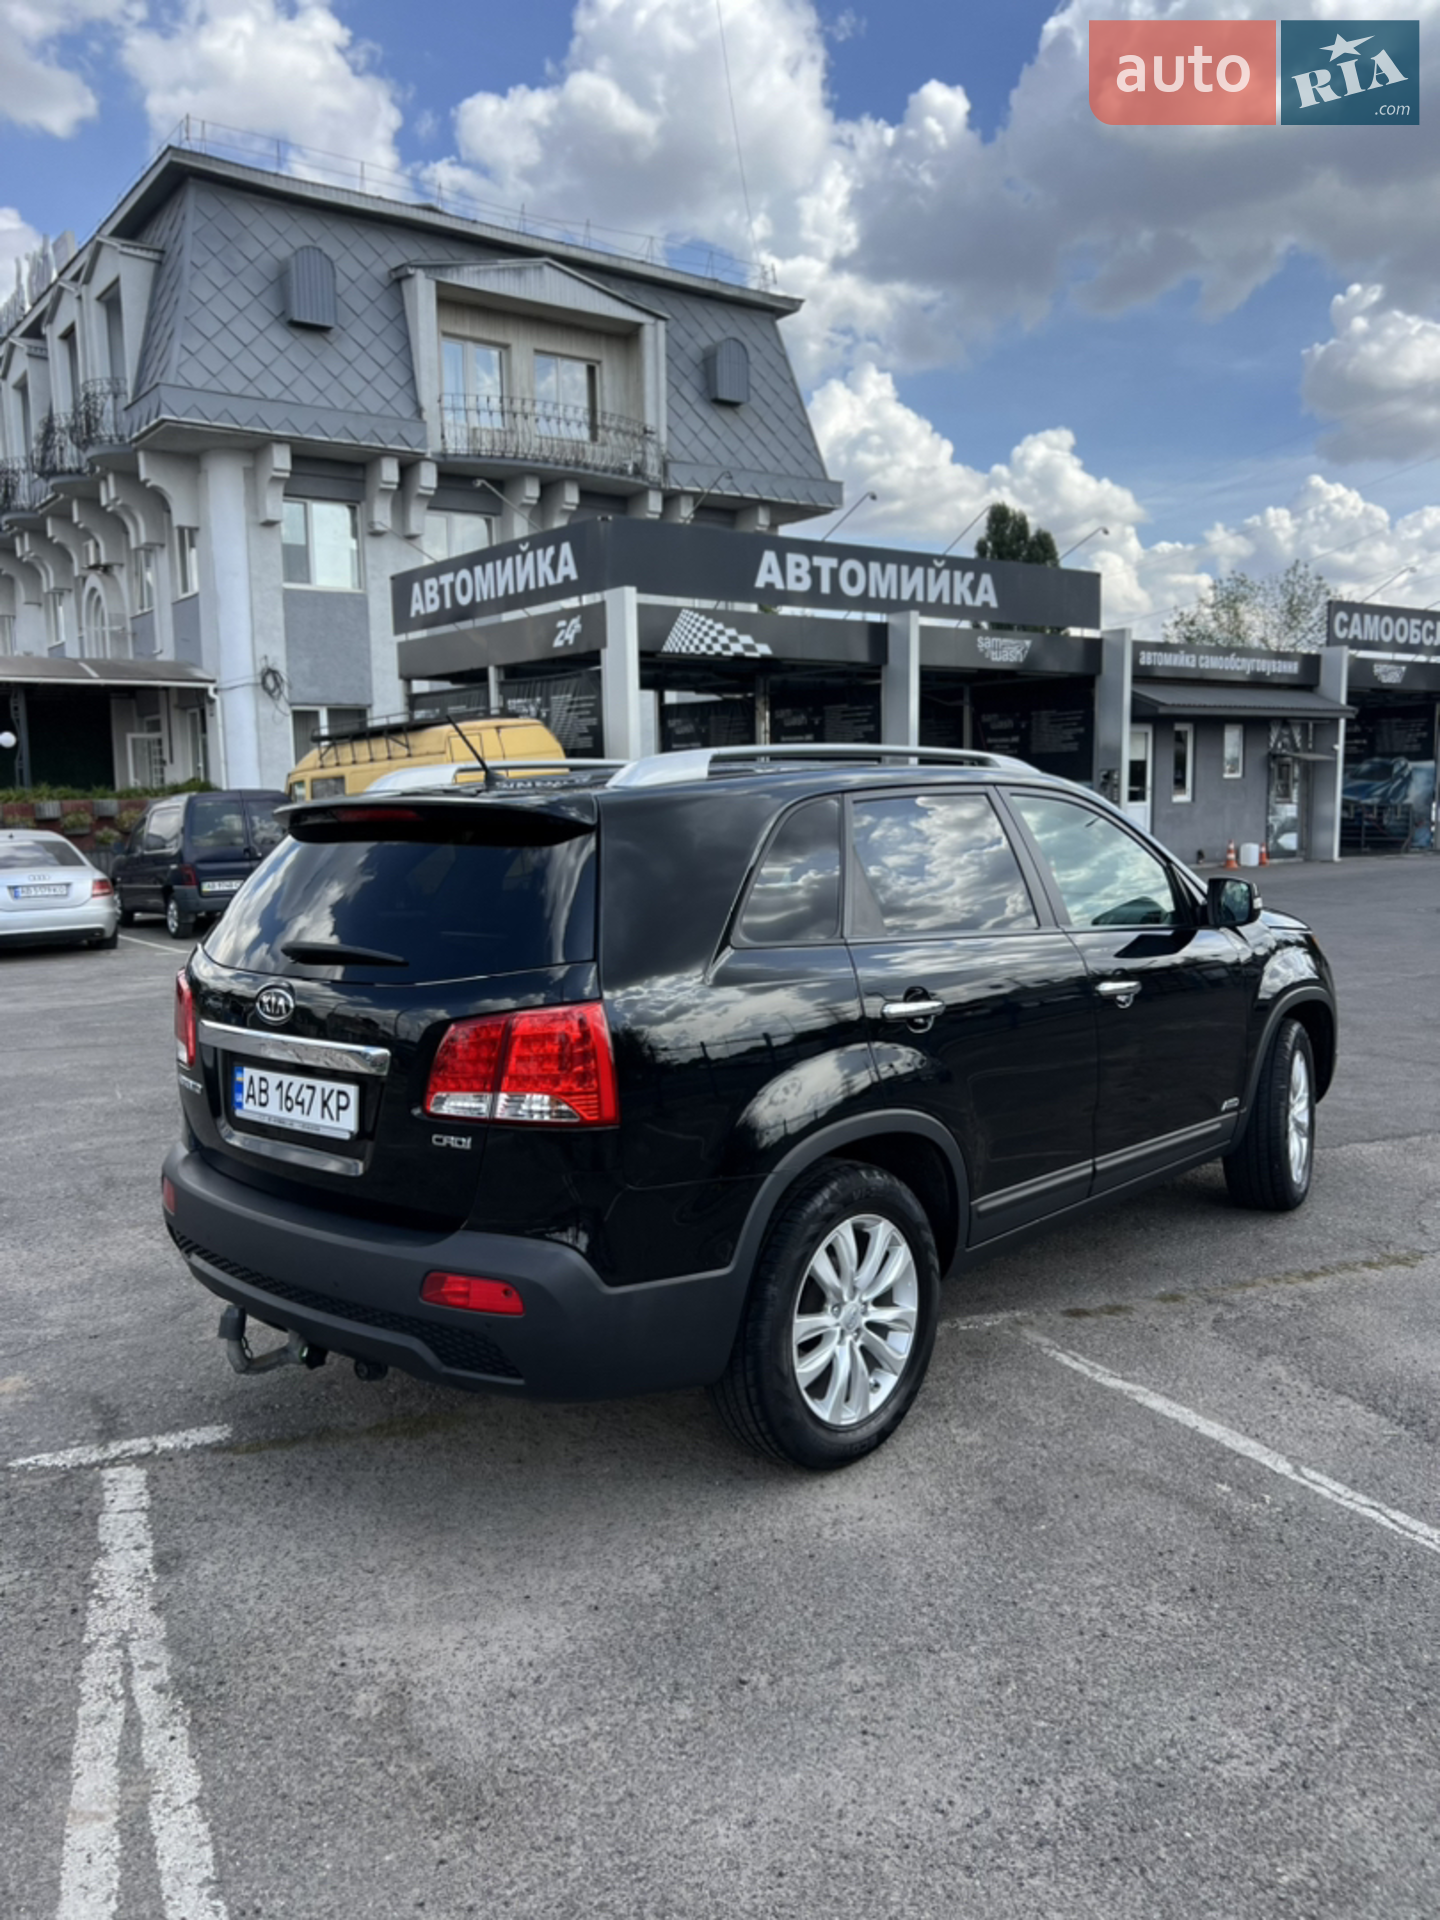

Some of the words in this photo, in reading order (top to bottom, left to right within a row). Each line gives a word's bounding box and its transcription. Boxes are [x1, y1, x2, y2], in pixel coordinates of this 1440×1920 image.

[410, 541, 578, 618] АВТОМИЙКА
[754, 550, 998, 608] АВТОМИЙКА
[553, 615, 582, 648] 24
[1139, 650, 1196, 668] автомийка
[261, 991, 287, 1015] KIA
[245, 1075, 269, 1108] AB
[275, 1080, 316, 1117] 1647
[321, 1087, 351, 1122] KP
